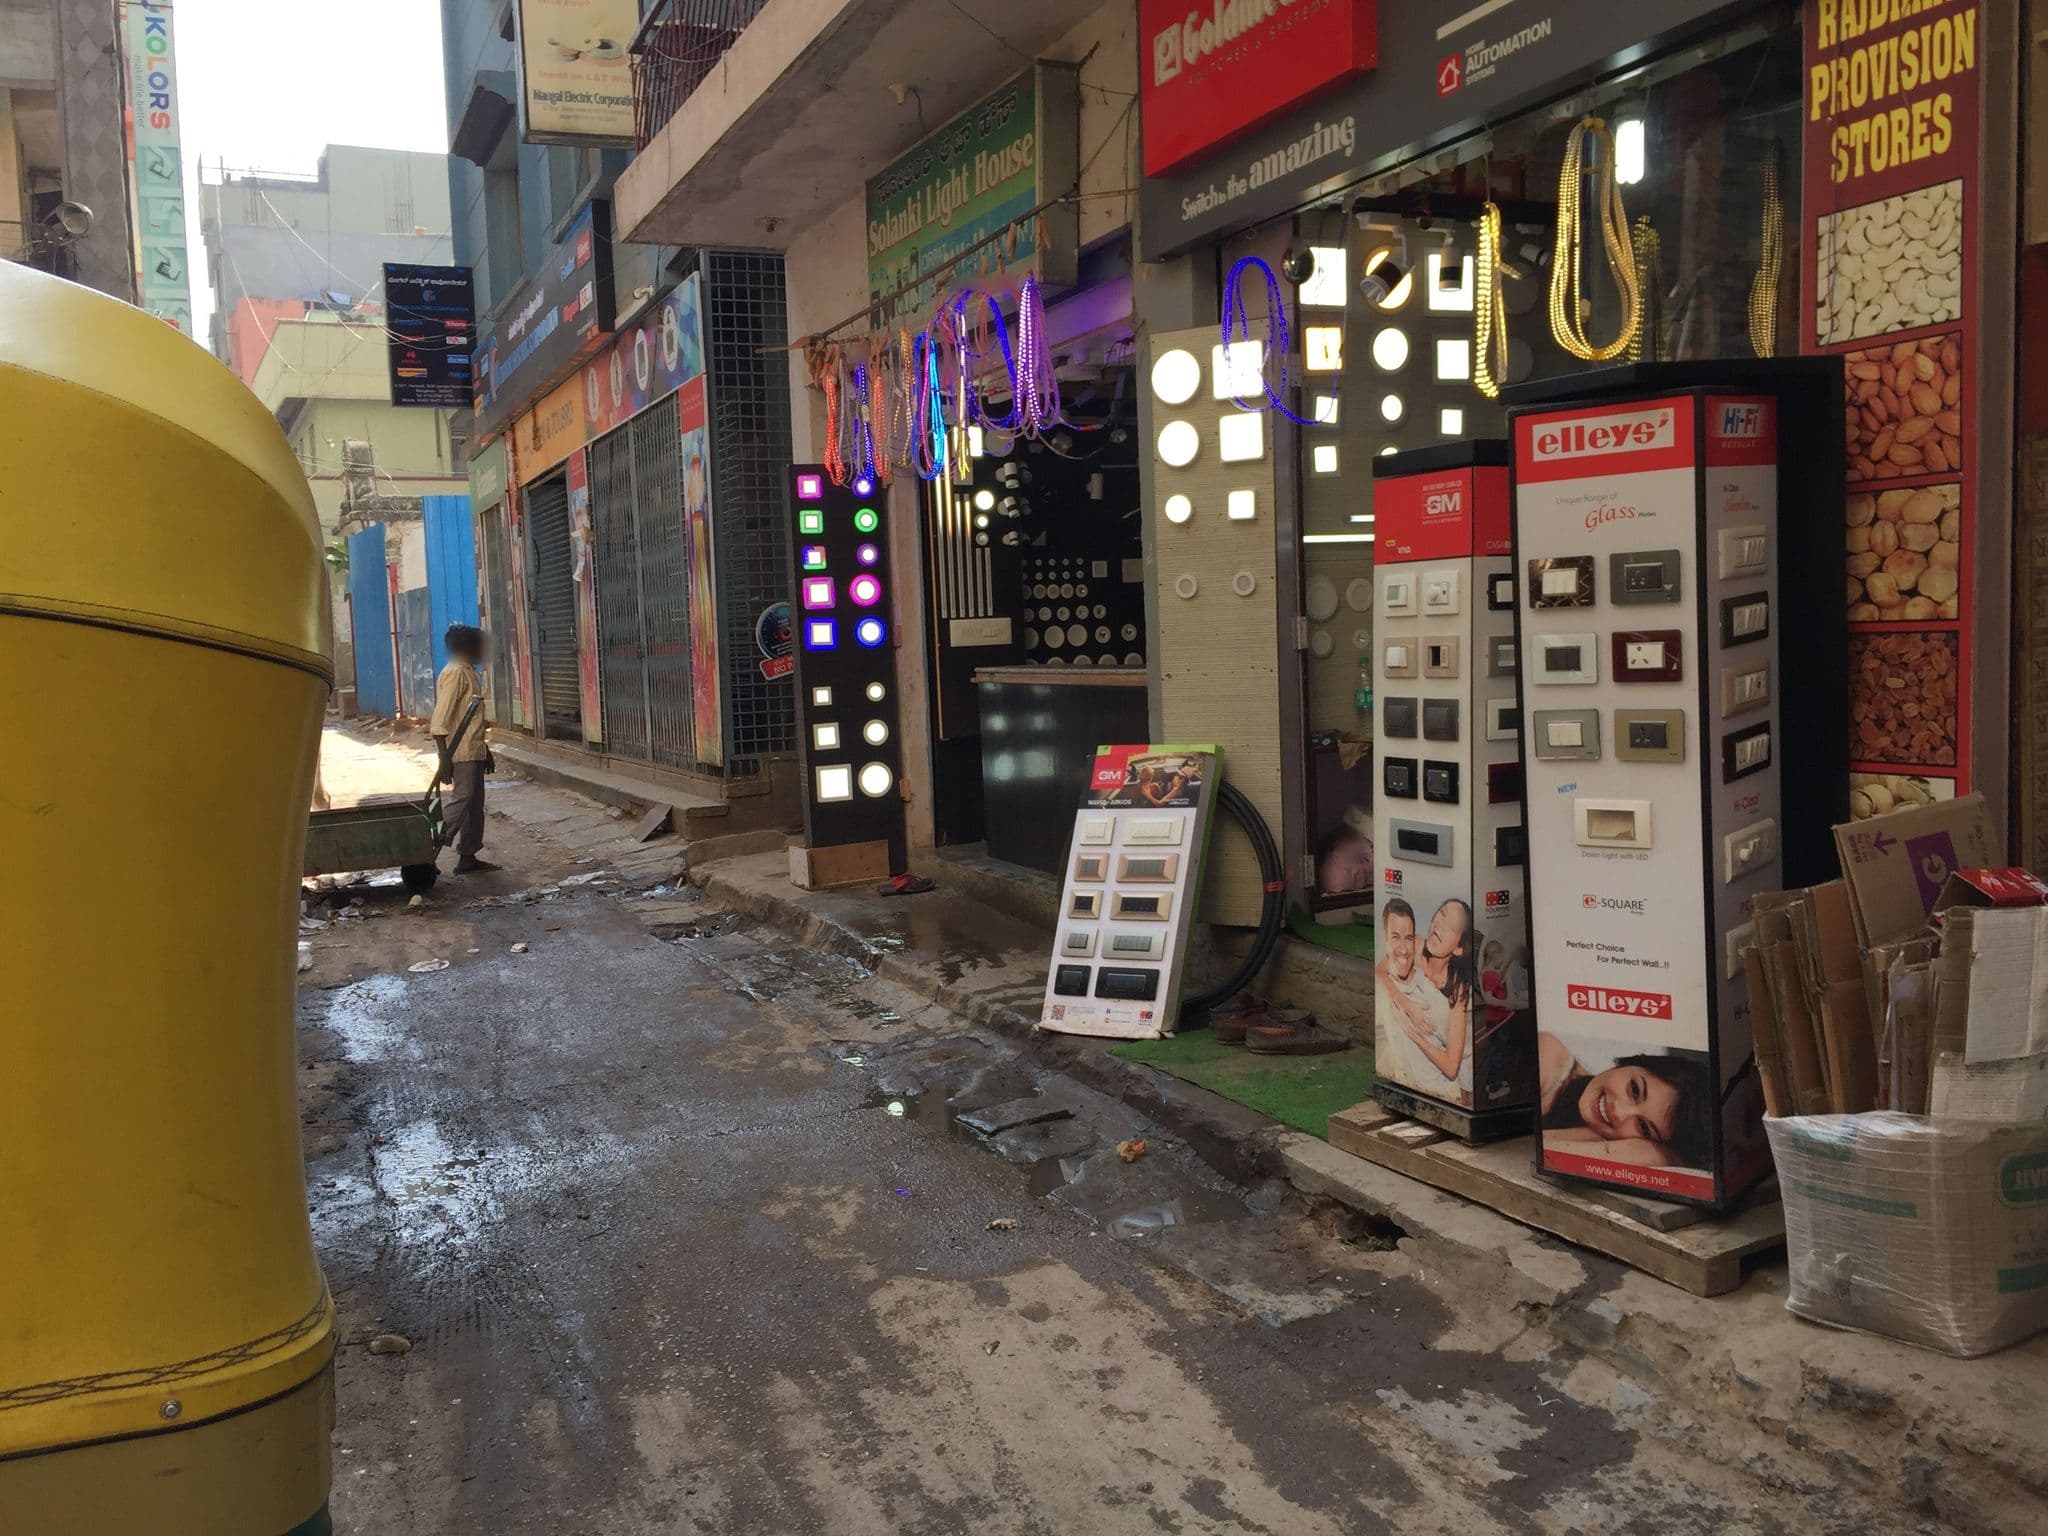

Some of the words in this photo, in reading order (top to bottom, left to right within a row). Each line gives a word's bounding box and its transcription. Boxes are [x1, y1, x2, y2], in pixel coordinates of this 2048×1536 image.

[1465, 18, 1552, 74] AUTOMATION
[144, 16, 171, 129] KOLORS
[1465, 65, 1496, 86] SYSTEMS
[1810, 8, 1976, 121] PROVISION
[533, 90, 562, 105] Mangal
[564, 91, 593, 104] Electric
[1831, 93, 1953, 184] STORES
[1181, 184, 1218, 221] Switch
[1227, 174, 1248, 198] the
[1250, 116, 1355, 189] amazing
[870, 191, 922, 257] Solanki
[926, 164, 969, 228] Light
[974, 132, 1033, 198] House
[1425, 492, 1461, 515] GM
[1556, 494, 1582, 506] Unique
[1583, 493, 1608, 505] Range
[1609, 491, 1618, 501] of
[1584, 502, 1636, 533] Glass
[1098, 771, 1121, 781] GM
[1557, 781, 1578, 795] NEW
[1566, 940, 1594, 951] Perfect
[1596, 942, 1625, 953] Choice
[1597, 955, 1609, 964] For
[1611, 956, 1640, 967] Perfect
[1585, 1163, 1670, 1187] www.elleys.net
